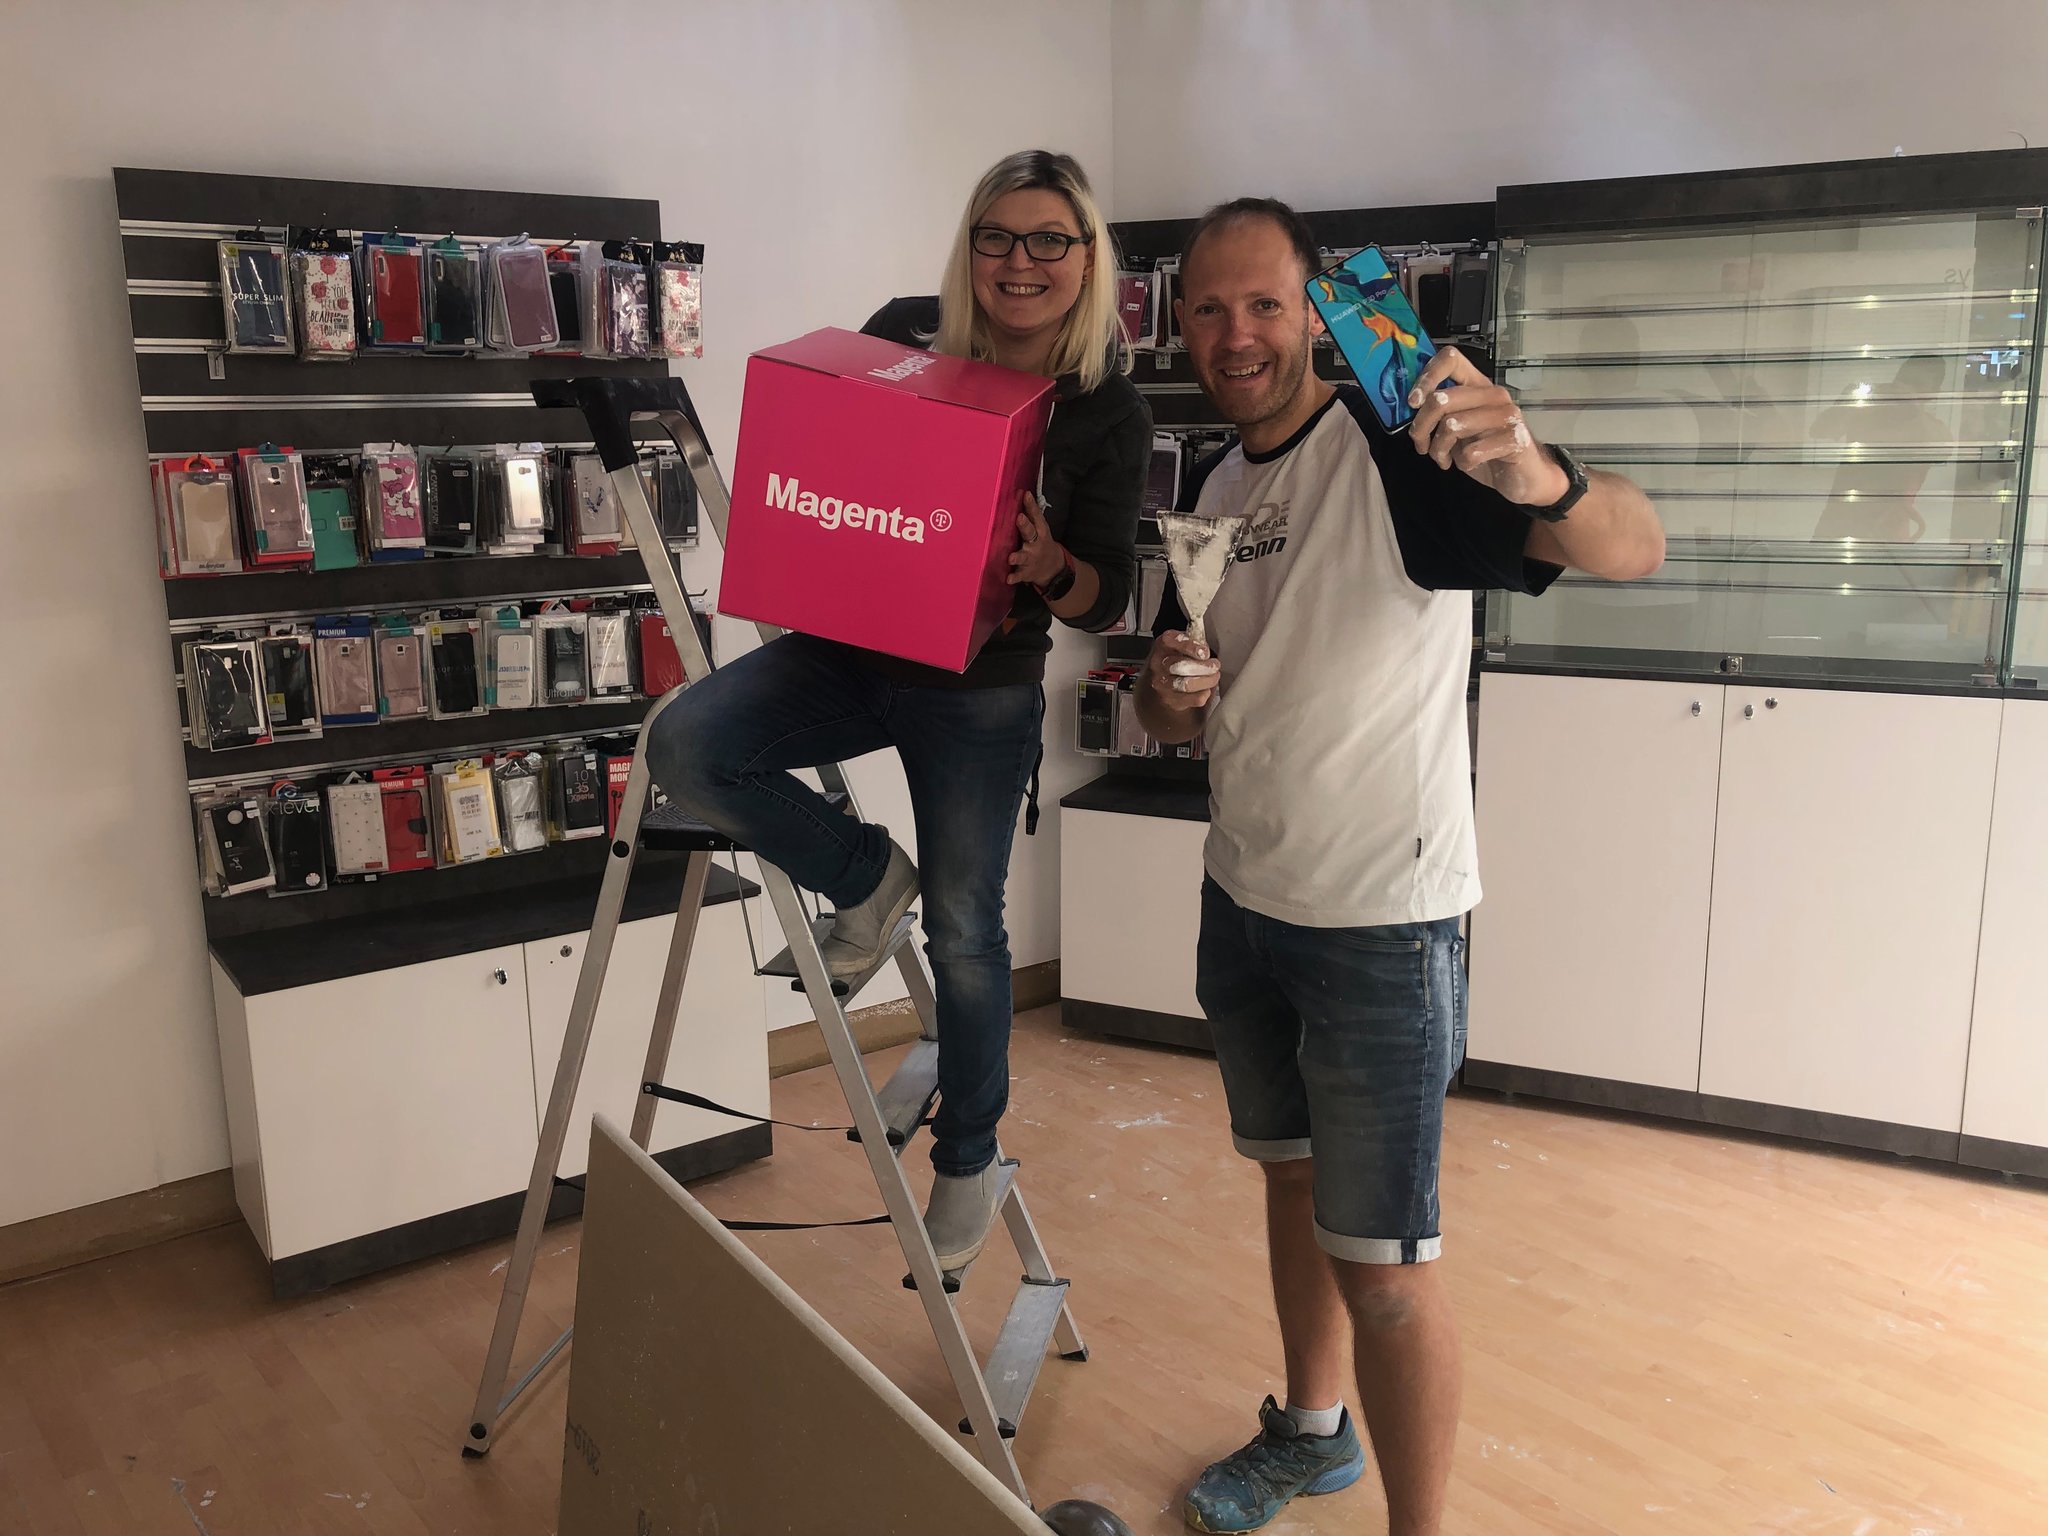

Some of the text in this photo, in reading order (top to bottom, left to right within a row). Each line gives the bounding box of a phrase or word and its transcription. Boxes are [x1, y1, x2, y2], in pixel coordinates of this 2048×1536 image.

[233, 292, 284, 302] SUPER SLIM
[1330, 302, 1362, 323] HUAWEI
[1375, 289, 1387, 298] Pro
[866, 355, 937, 381] Magenta
[765, 472, 925, 544] Magenta
[317, 628, 347, 637] PREMIUM
[609, 762, 632, 773] MAGI
[574, 769, 589, 782] 10
[610, 772, 630, 783] MON
[381, 780, 404, 789] REMIUM
[574, 782, 590, 794] 35
[569, 793, 595, 803] Xperia
